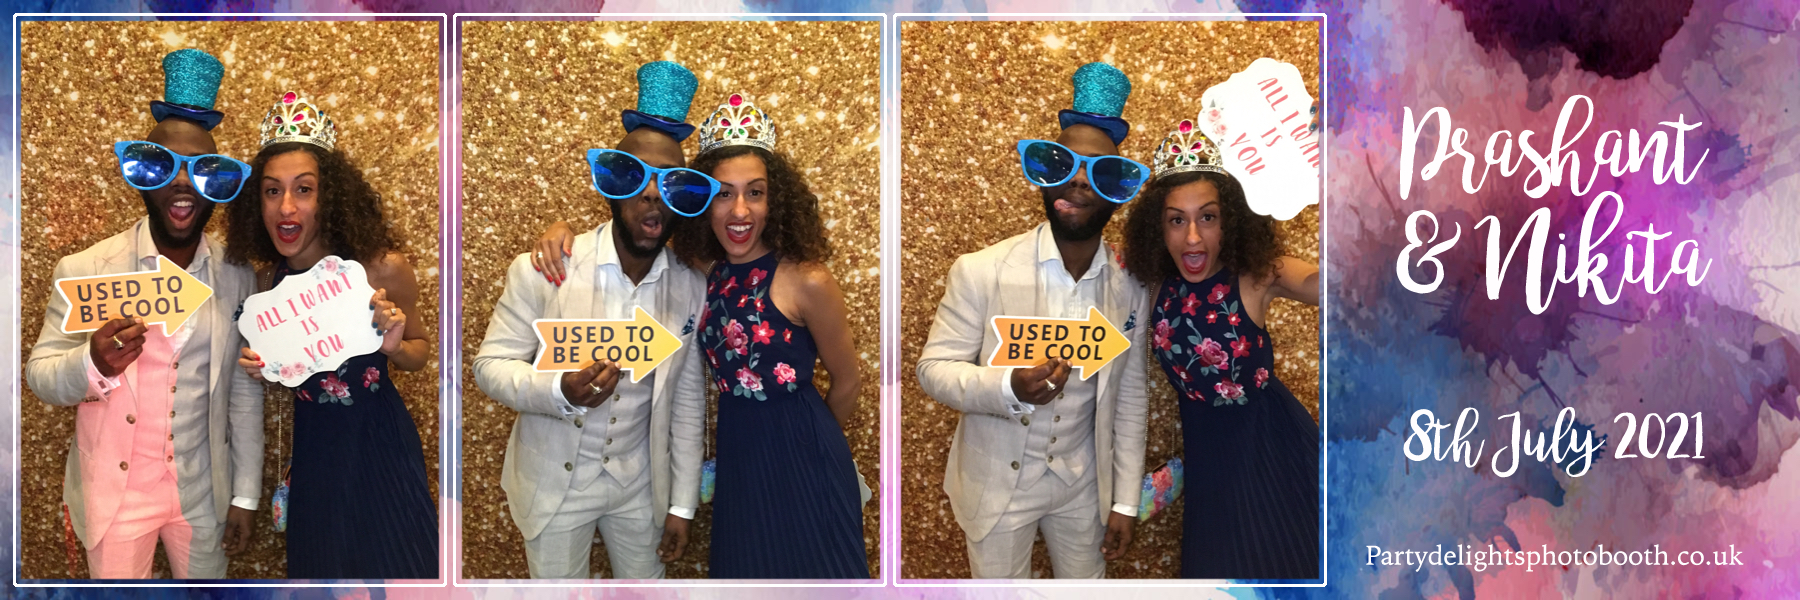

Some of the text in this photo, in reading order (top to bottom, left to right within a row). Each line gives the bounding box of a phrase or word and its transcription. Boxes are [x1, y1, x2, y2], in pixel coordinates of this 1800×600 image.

[1257, 77, 1319, 178] ALL I WAN
[1260, 127, 1283, 147] IS
[1229, 132, 1266, 175] YOU
[77, 276, 183, 302] USED TO
[80, 296, 185, 323] BE COOL
[255, 272, 352, 333] ALL I WANT
[300, 316, 320, 336] IS
[553, 326, 654, 344] USED TO
[1010, 324, 1106, 342] USED TO
[303, 334, 344, 363] YOU
[553, 345, 653, 363] BE COOL
[1008, 343, 1103, 361] BE COOL
